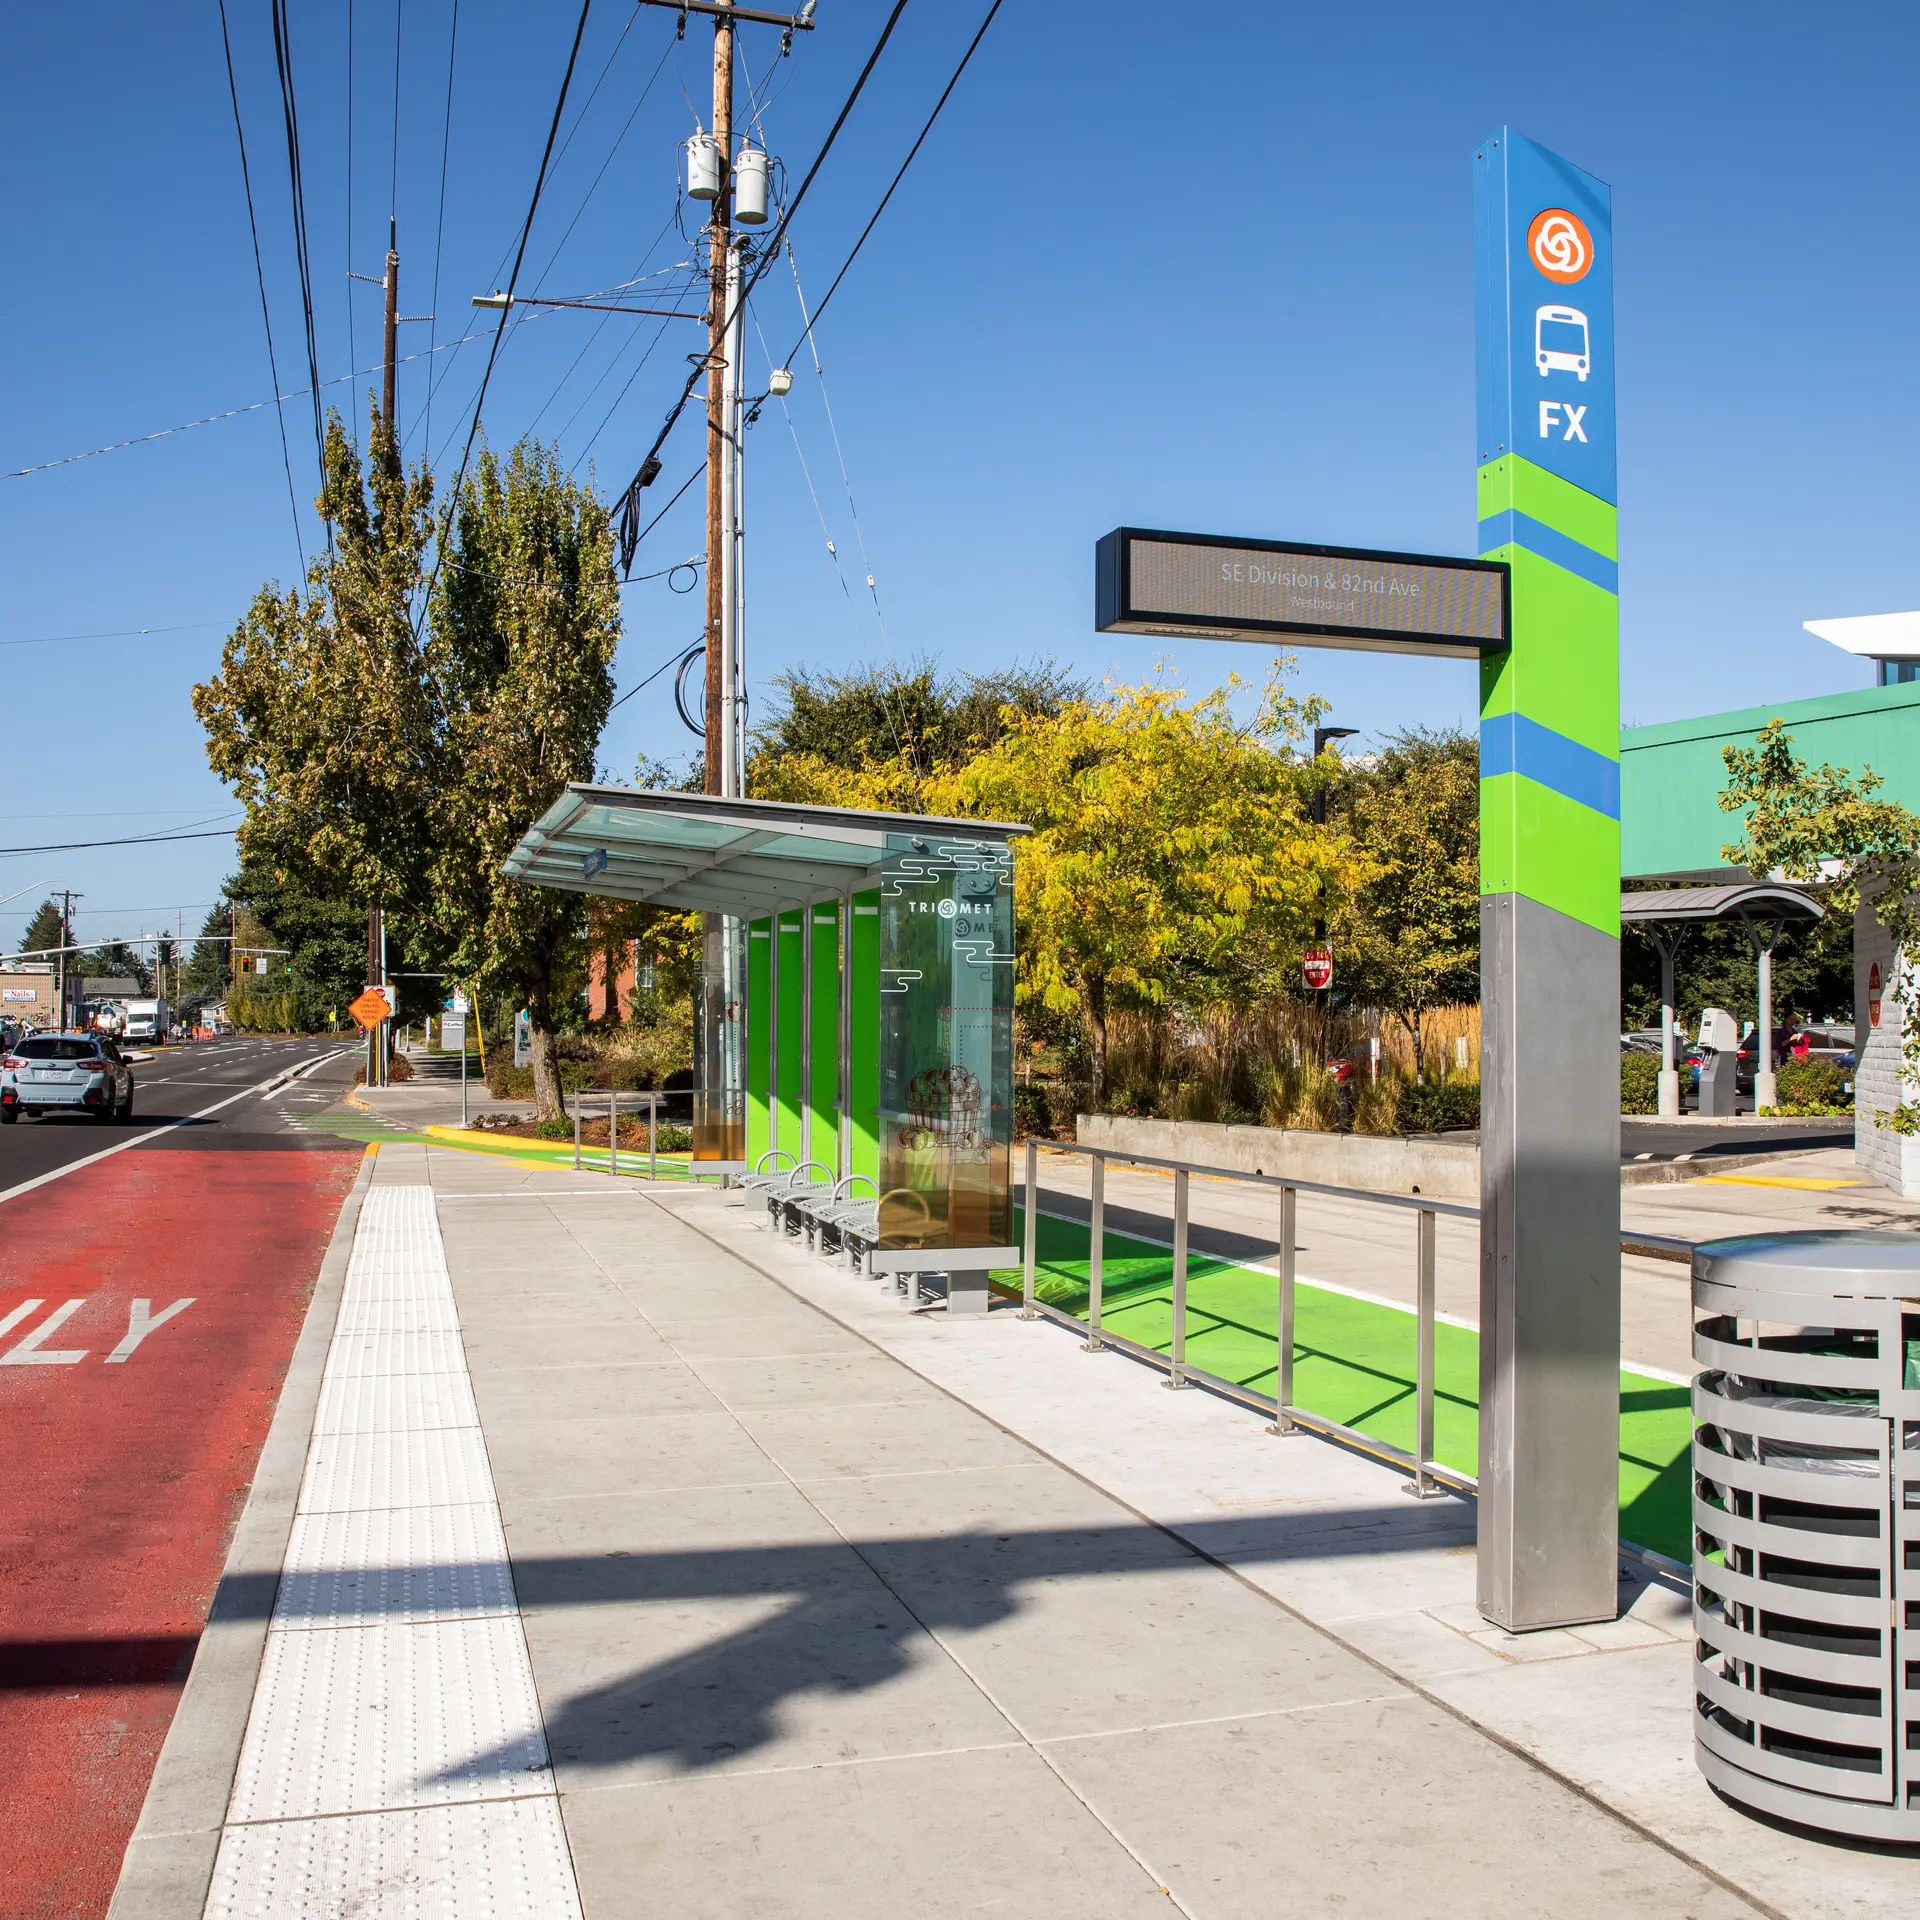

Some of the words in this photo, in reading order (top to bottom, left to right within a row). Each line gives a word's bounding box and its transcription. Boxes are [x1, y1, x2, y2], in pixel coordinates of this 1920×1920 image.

[1538, 400, 1589, 443] FX
[1221, 563, 1243, 582] SE
[1249, 565, 1319, 588] Division
[1324, 572, 1337, 590] &
[1341, 573, 1384, 594] 82nd
[1389, 578, 1420, 597] Ave
[1290, 595, 1353, 612] Westbound
